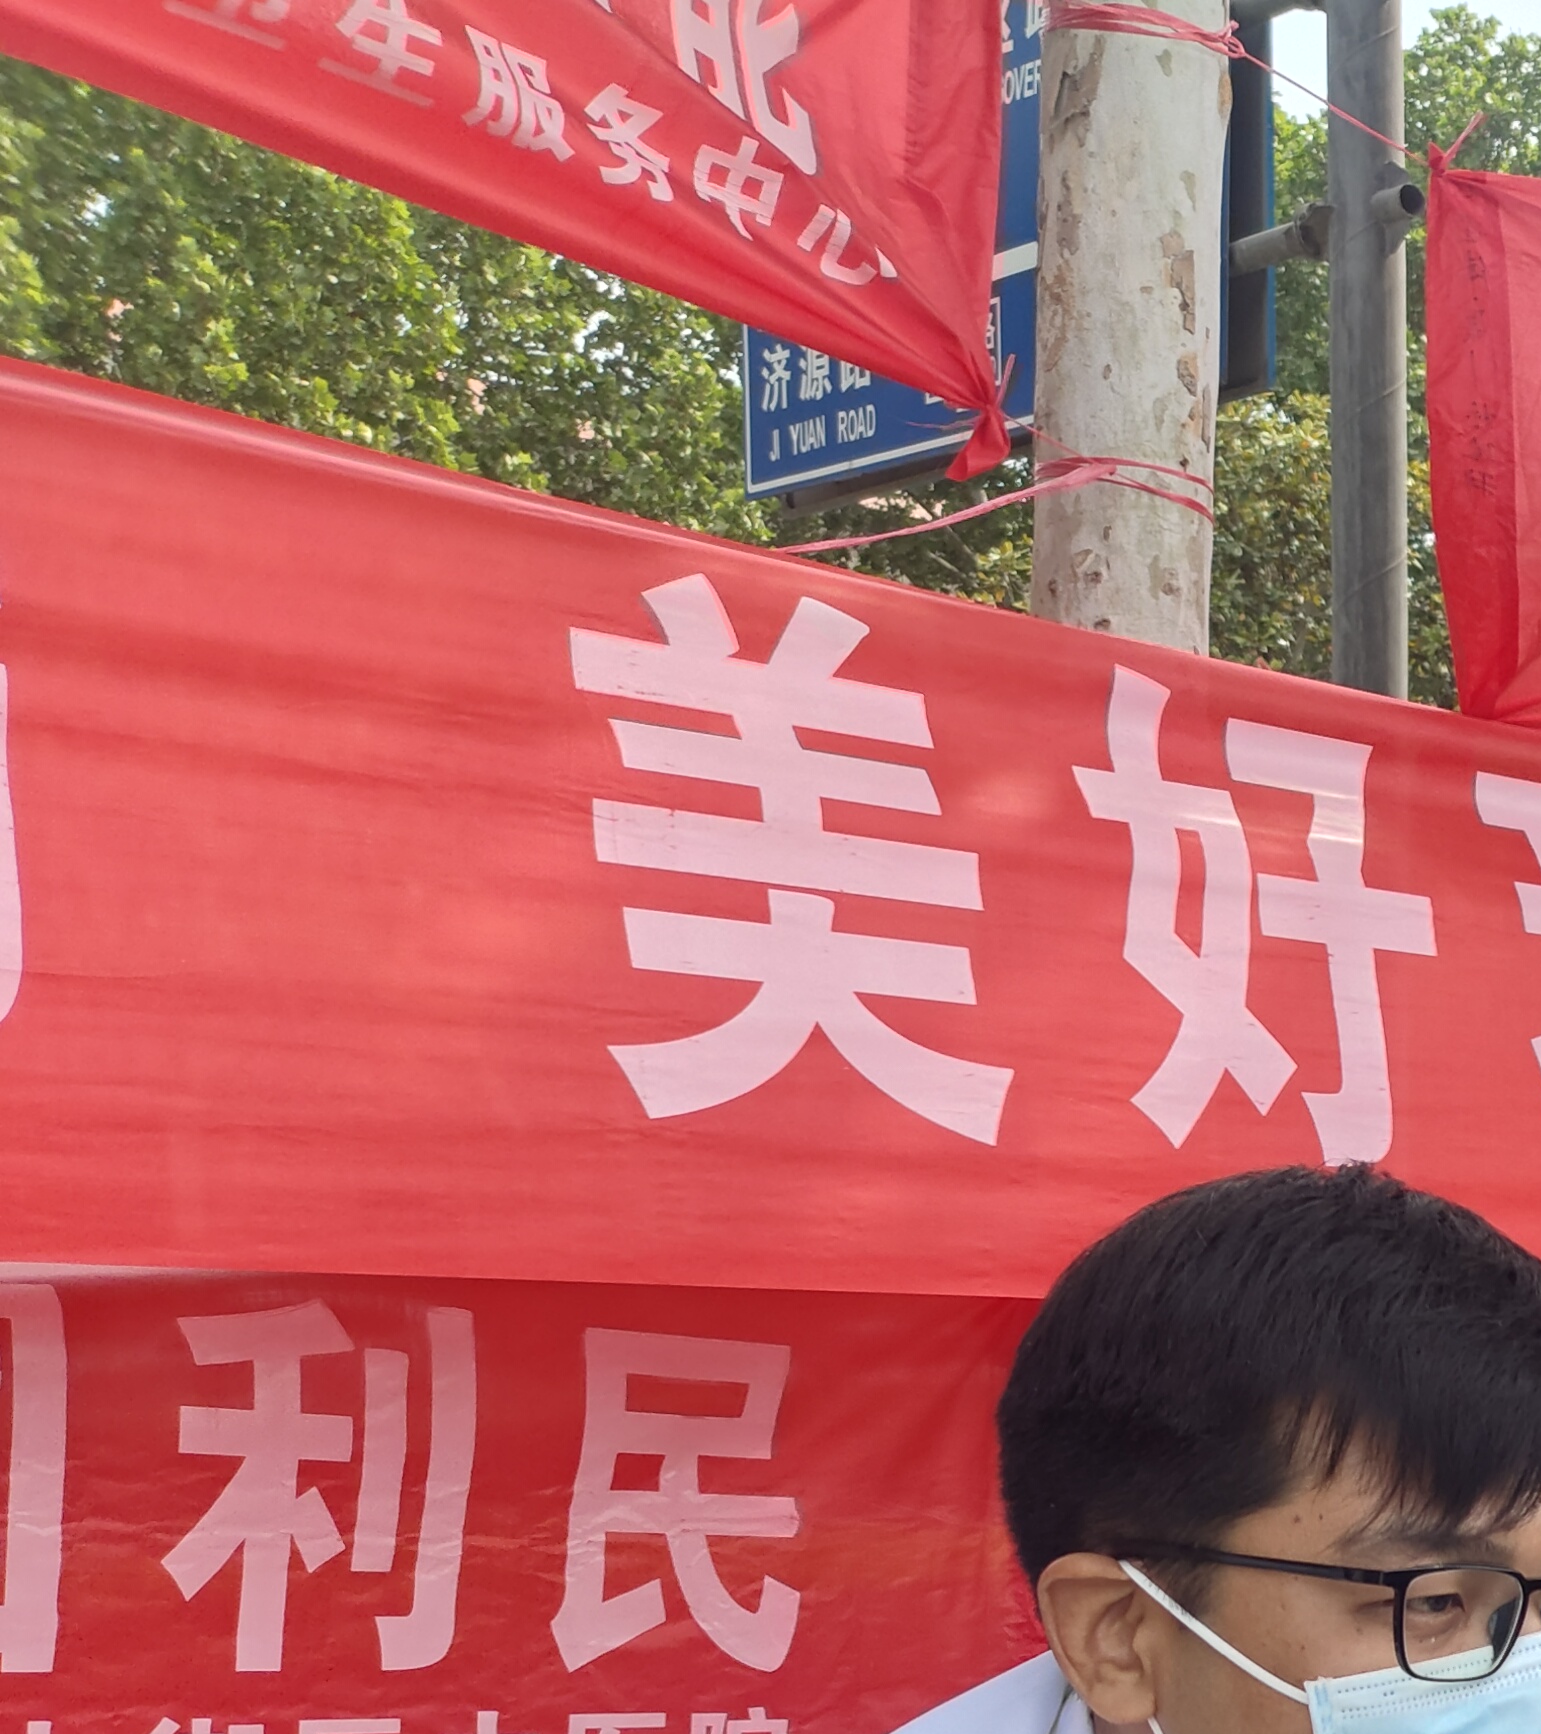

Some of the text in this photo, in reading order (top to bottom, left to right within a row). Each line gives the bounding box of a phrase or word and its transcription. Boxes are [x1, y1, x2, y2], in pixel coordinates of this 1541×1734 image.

[789, 415, 826, 456] YUAN
[837, 404, 876, 444] ROAD
[0, 1283, 801, 1674] 利民
